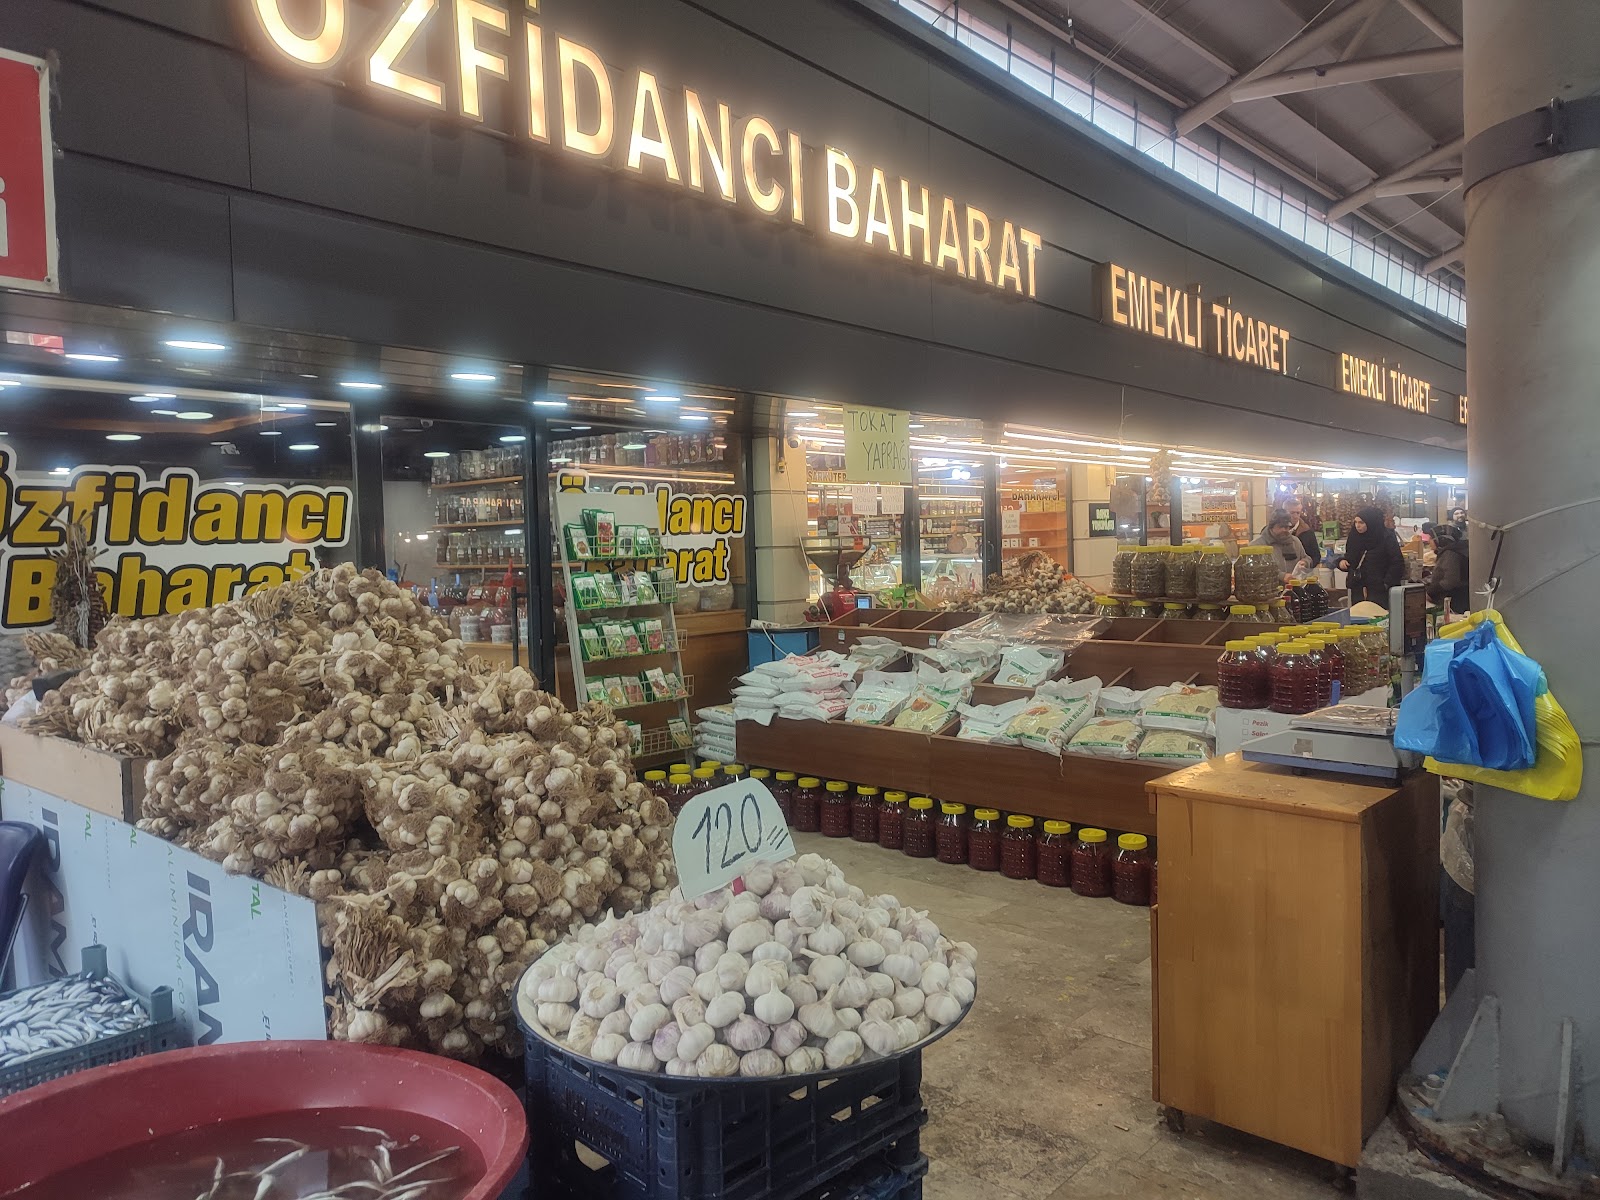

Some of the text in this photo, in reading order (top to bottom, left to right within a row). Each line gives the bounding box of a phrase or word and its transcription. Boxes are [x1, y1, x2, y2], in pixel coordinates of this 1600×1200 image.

[826, 146, 1042, 299] BAHARAT
[1110, 263, 1290, 374] EMEKLİ TİCARET
[847, 410, 897, 434] TOKAT
[1341, 353, 1430, 414] EMEKLİ TİCARET
[0, 452, 350, 546] zfidancı
[691, 792, 762, 875] 120
[165, 844, 183, 971] ALUMINIUM
